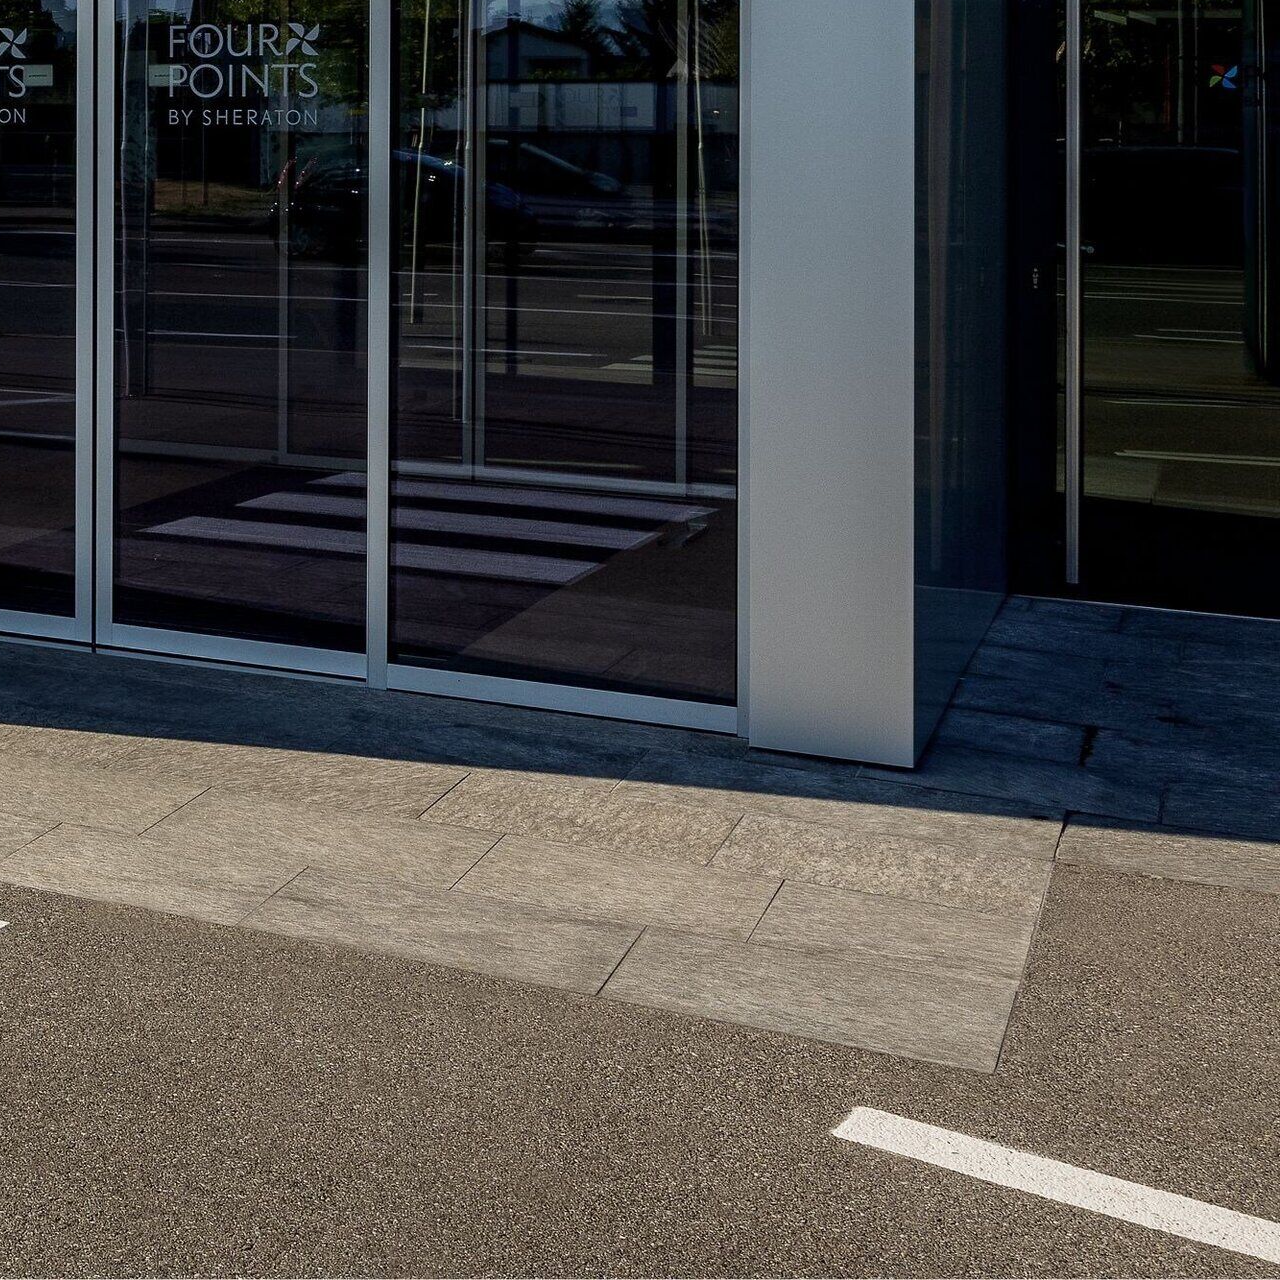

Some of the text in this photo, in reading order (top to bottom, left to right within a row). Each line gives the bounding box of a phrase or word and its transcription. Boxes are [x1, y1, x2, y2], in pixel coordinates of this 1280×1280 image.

[169, 23, 284, 59] FOUR
[169, 63, 319, 98] POINTS
[169, 109, 318, 126] BY SHERATON
